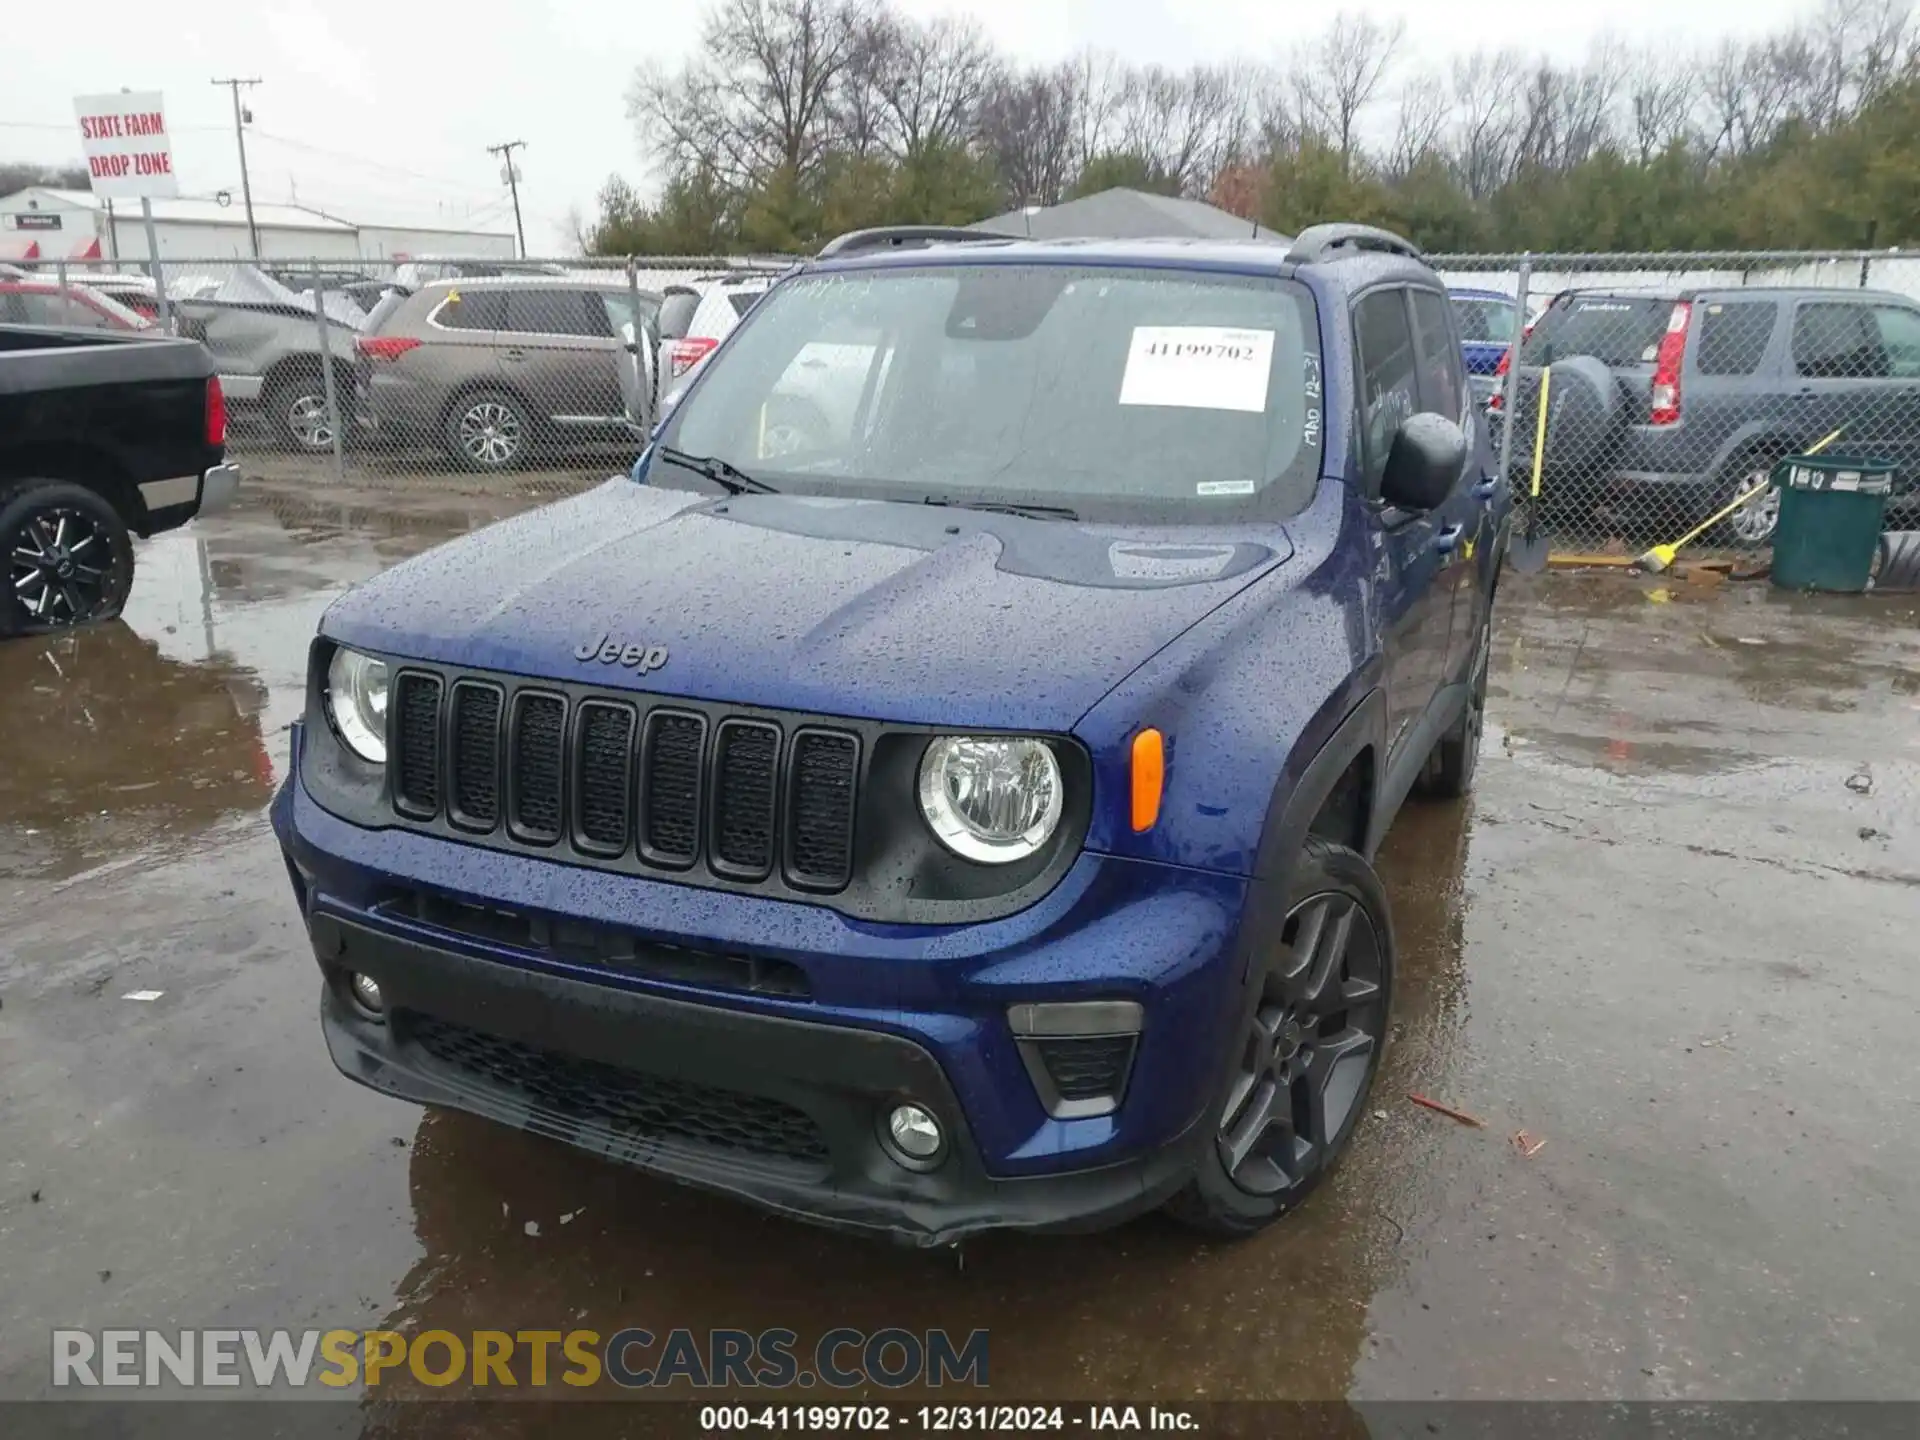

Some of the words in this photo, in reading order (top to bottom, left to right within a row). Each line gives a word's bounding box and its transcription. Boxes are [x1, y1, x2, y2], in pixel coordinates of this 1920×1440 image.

[80, 114, 122, 139] STATE
[124, 112, 164, 136] FARM
[89, 154, 129, 178] DROP
[132, 151, 170, 175] ZONE
[1144, 341, 1254, 361] 41199702
[574, 633, 670, 677] Jeep
